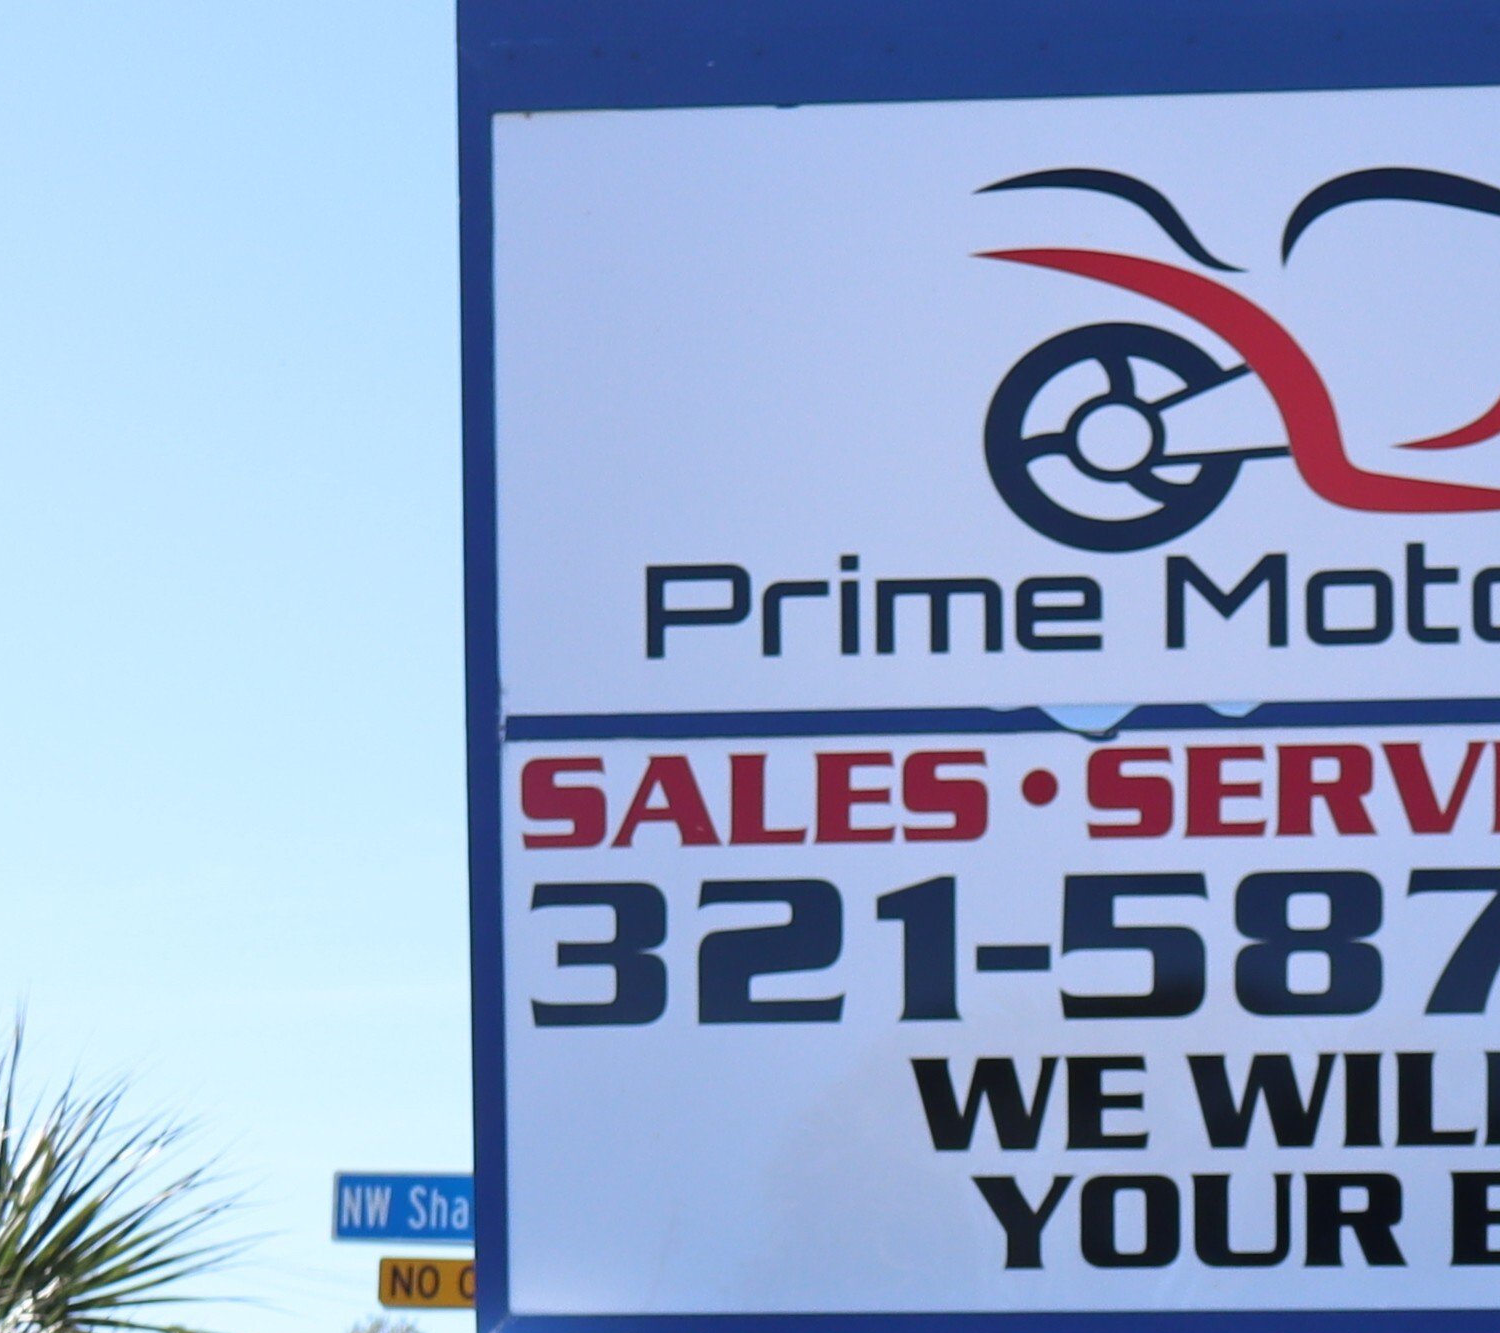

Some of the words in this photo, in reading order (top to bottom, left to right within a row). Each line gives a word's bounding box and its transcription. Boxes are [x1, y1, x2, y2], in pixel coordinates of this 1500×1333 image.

[645, 552, 1104, 660] Prime
[523, 751, 986, 848] SALES
[911, 1056, 1149, 1151] WE
[341, 1186, 392, 1228] NW
[972, 1172, 1407, 1269] YOUR
[390, 1264, 440, 1299] NO
